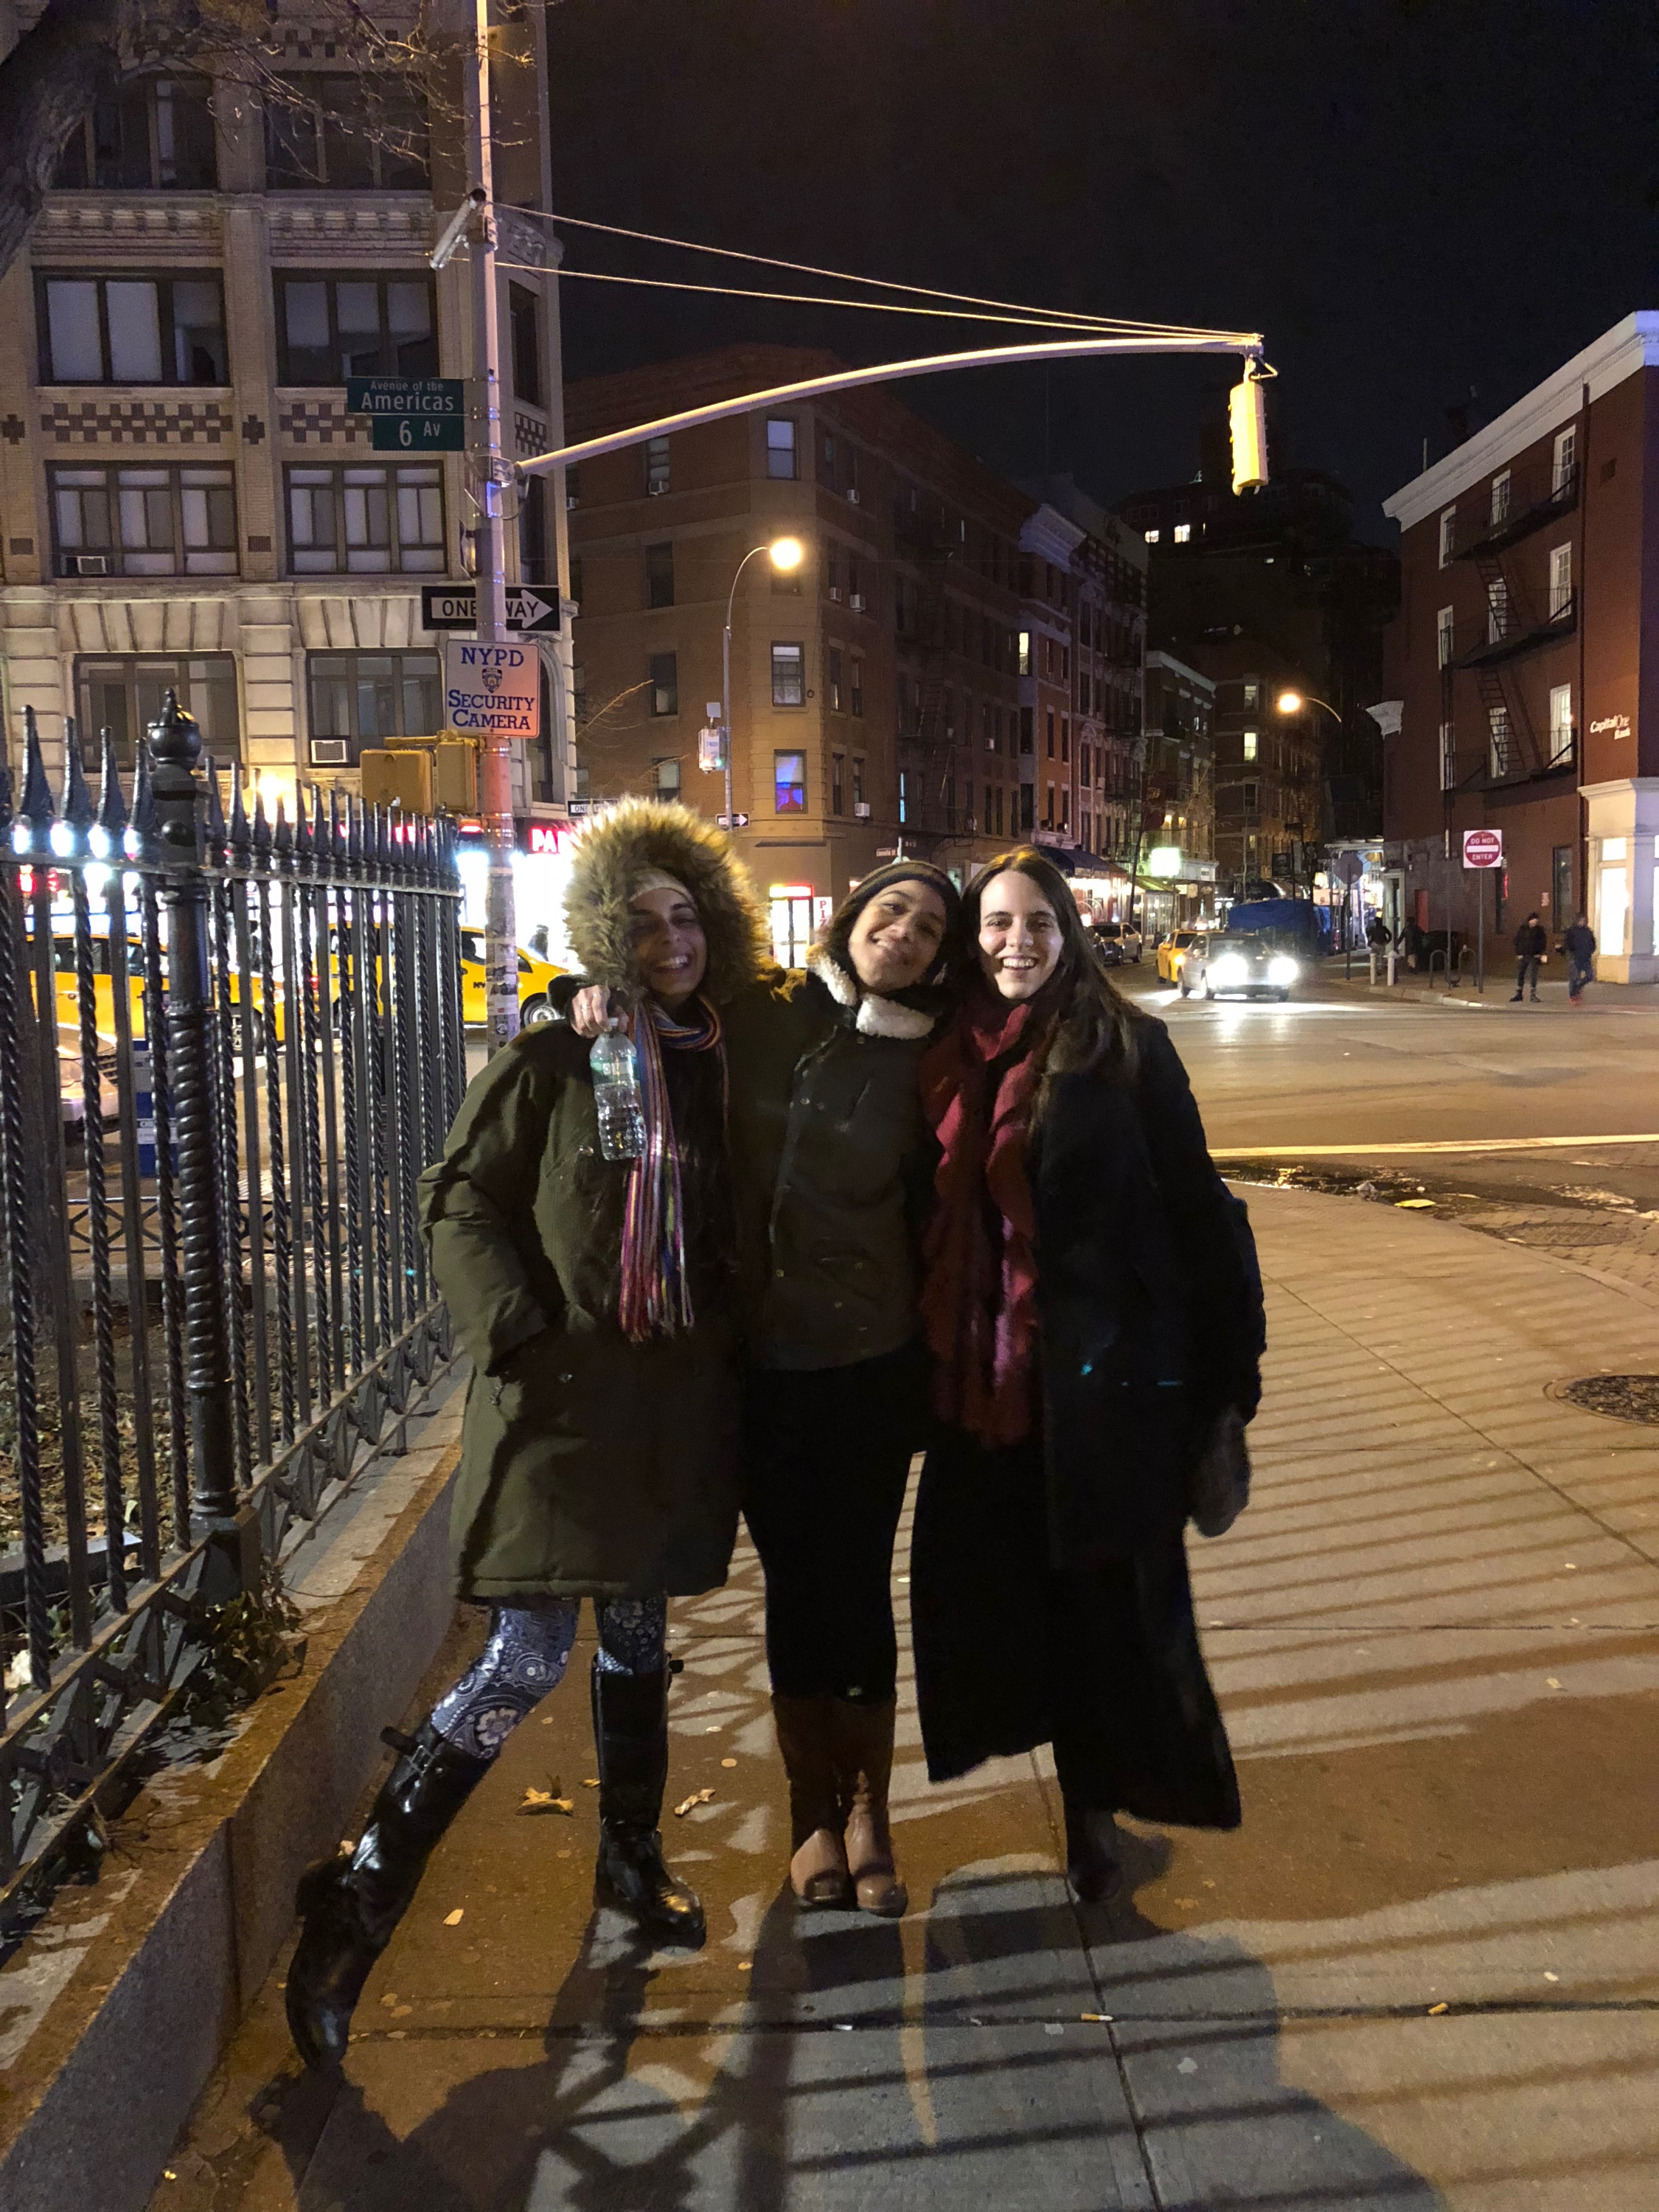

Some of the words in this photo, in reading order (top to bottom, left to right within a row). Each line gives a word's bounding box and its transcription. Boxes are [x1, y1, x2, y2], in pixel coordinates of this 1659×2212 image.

[370, 380, 401, 391] Avenue
[413, 381, 422, 391] of
[427, 381, 444, 392] the
[361, 392, 453, 411] Americas
[399, 420, 412, 447] 6
[461, 647, 524, 667] NYPD
[448, 689, 535, 712] SECURITY
[452, 709, 531, 730] CAMERA
